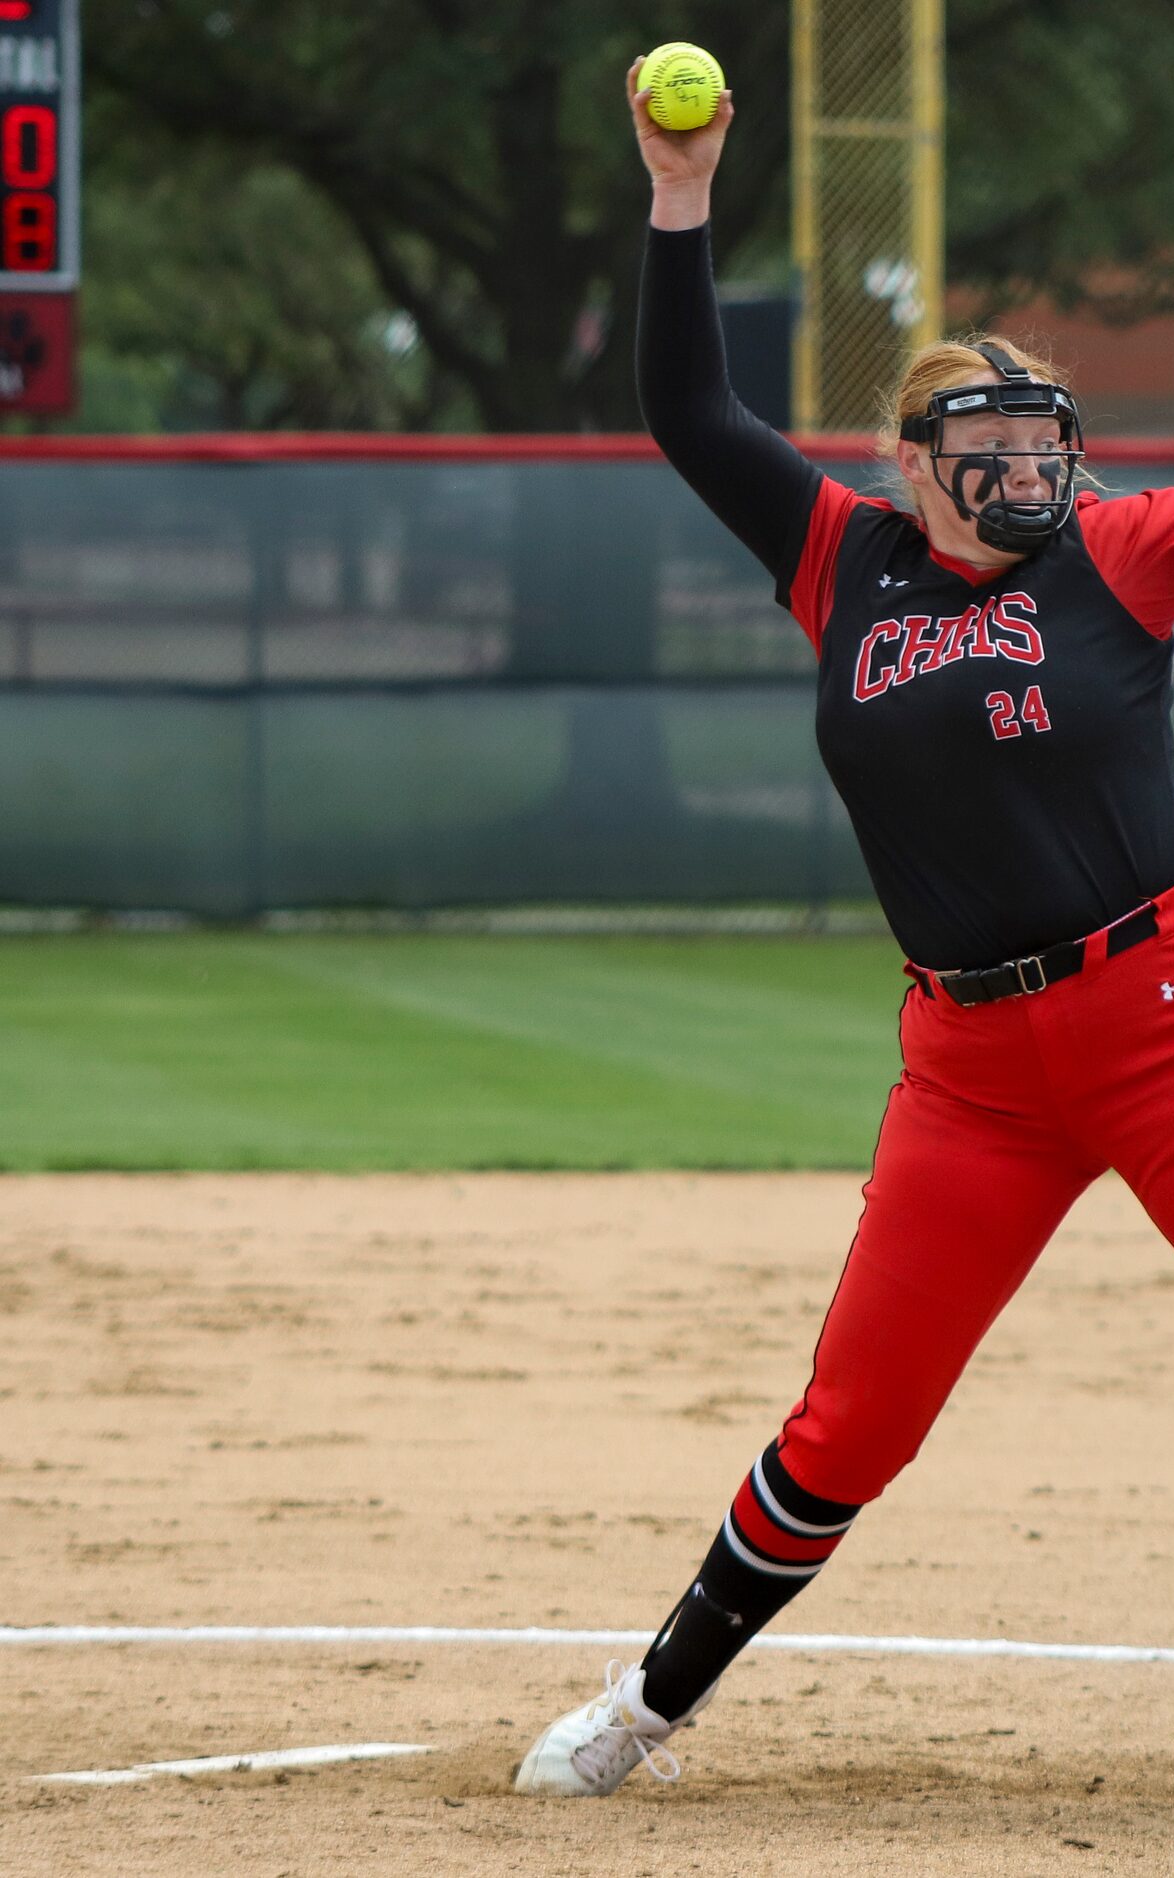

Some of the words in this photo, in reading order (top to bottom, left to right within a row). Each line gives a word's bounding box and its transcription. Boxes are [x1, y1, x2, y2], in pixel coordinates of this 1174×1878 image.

[2, 105, 56, 189] 0
[2, 190, 56, 272] 8
[985, 685, 1052, 741] 24
